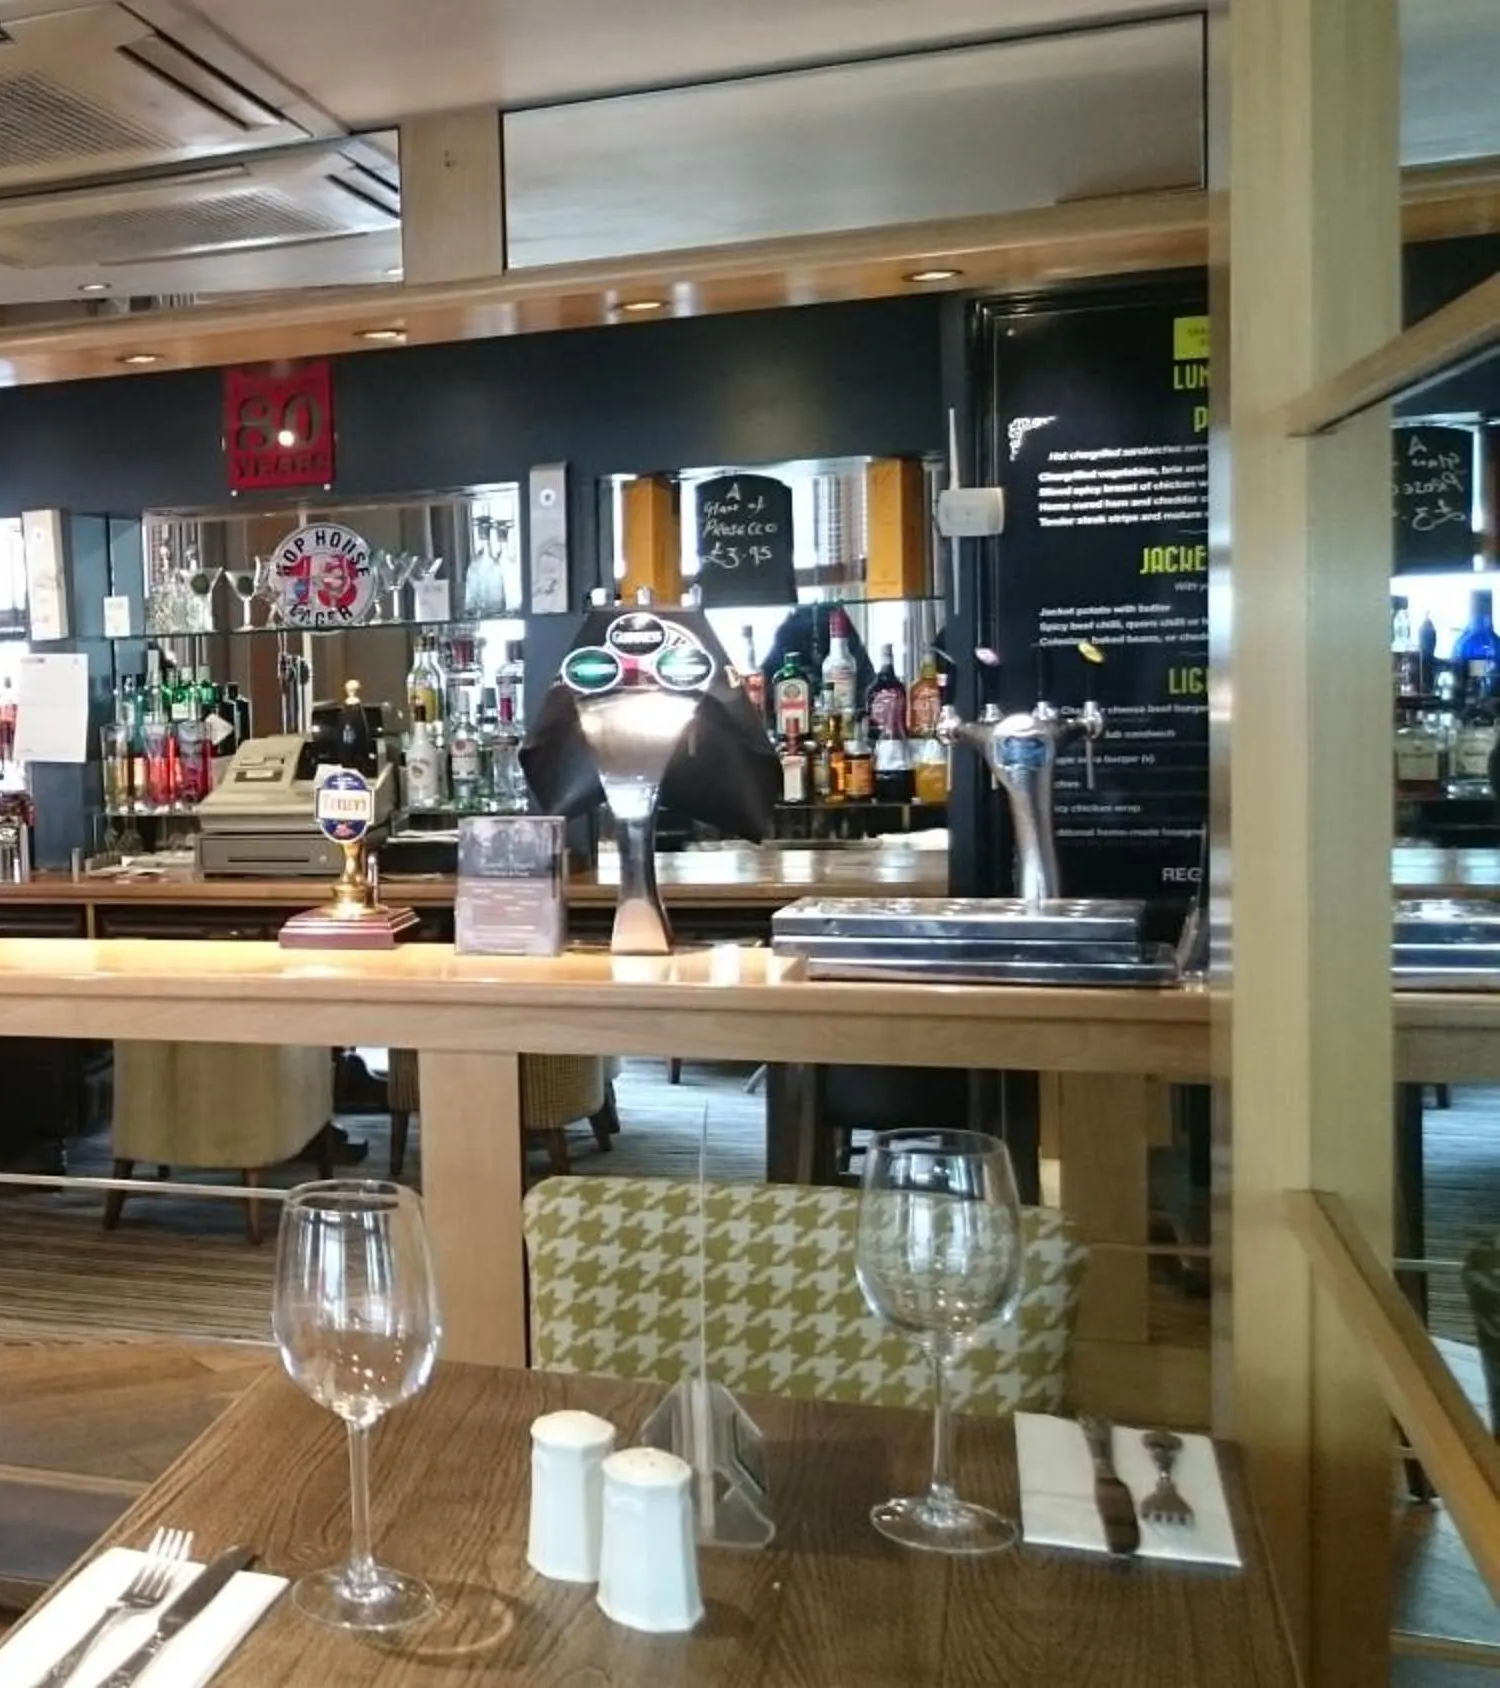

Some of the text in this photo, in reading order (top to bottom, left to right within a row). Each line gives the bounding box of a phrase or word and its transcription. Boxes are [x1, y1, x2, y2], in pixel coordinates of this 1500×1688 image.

[1174, 363, 1208, 390] LUN
[235, 394, 323, 452] 80
[276, 530, 370, 578] HOP HOUSE
[1140, 546, 1208, 574] JACKE
[1169, 667, 1208, 694] LIG
